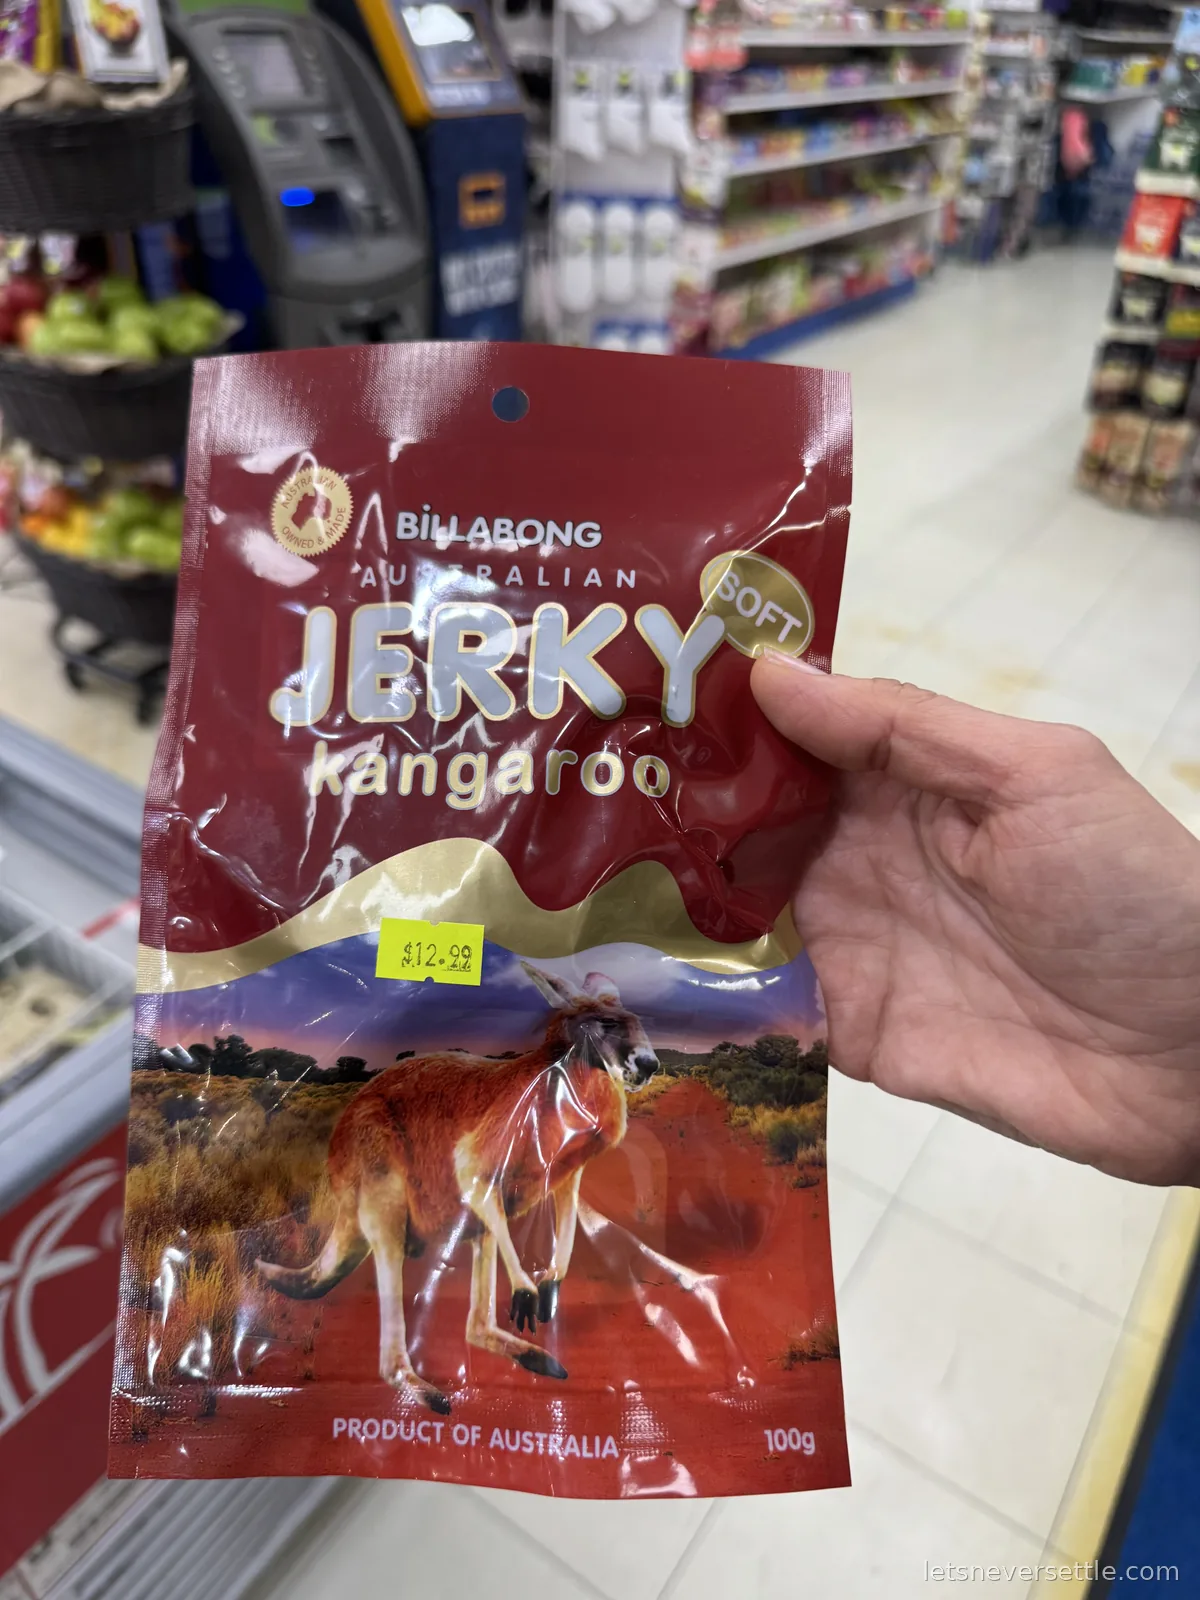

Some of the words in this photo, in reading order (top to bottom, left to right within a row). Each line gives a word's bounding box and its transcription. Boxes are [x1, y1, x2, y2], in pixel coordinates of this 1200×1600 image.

[281, 475, 337, 509] AUSTRAIAN
[282, 526, 315, 549] OWNED
[317, 536, 325, 546] &
[325, 506, 346, 539] MADE
[360, 564, 636, 589] AURALIAN
[716, 570, 803, 644] SOFT
[269, 601, 726, 728] JERKY
[309, 740, 671, 811] kangaroo
[401, 941, 473, 972] $12.99
[332, 1417, 445, 1443] PRODUCT
[452, 1422, 482, 1447] OF
[489, 1427, 620, 1459] AUSTRALIA
[763, 1427, 816, 1456] 100g
